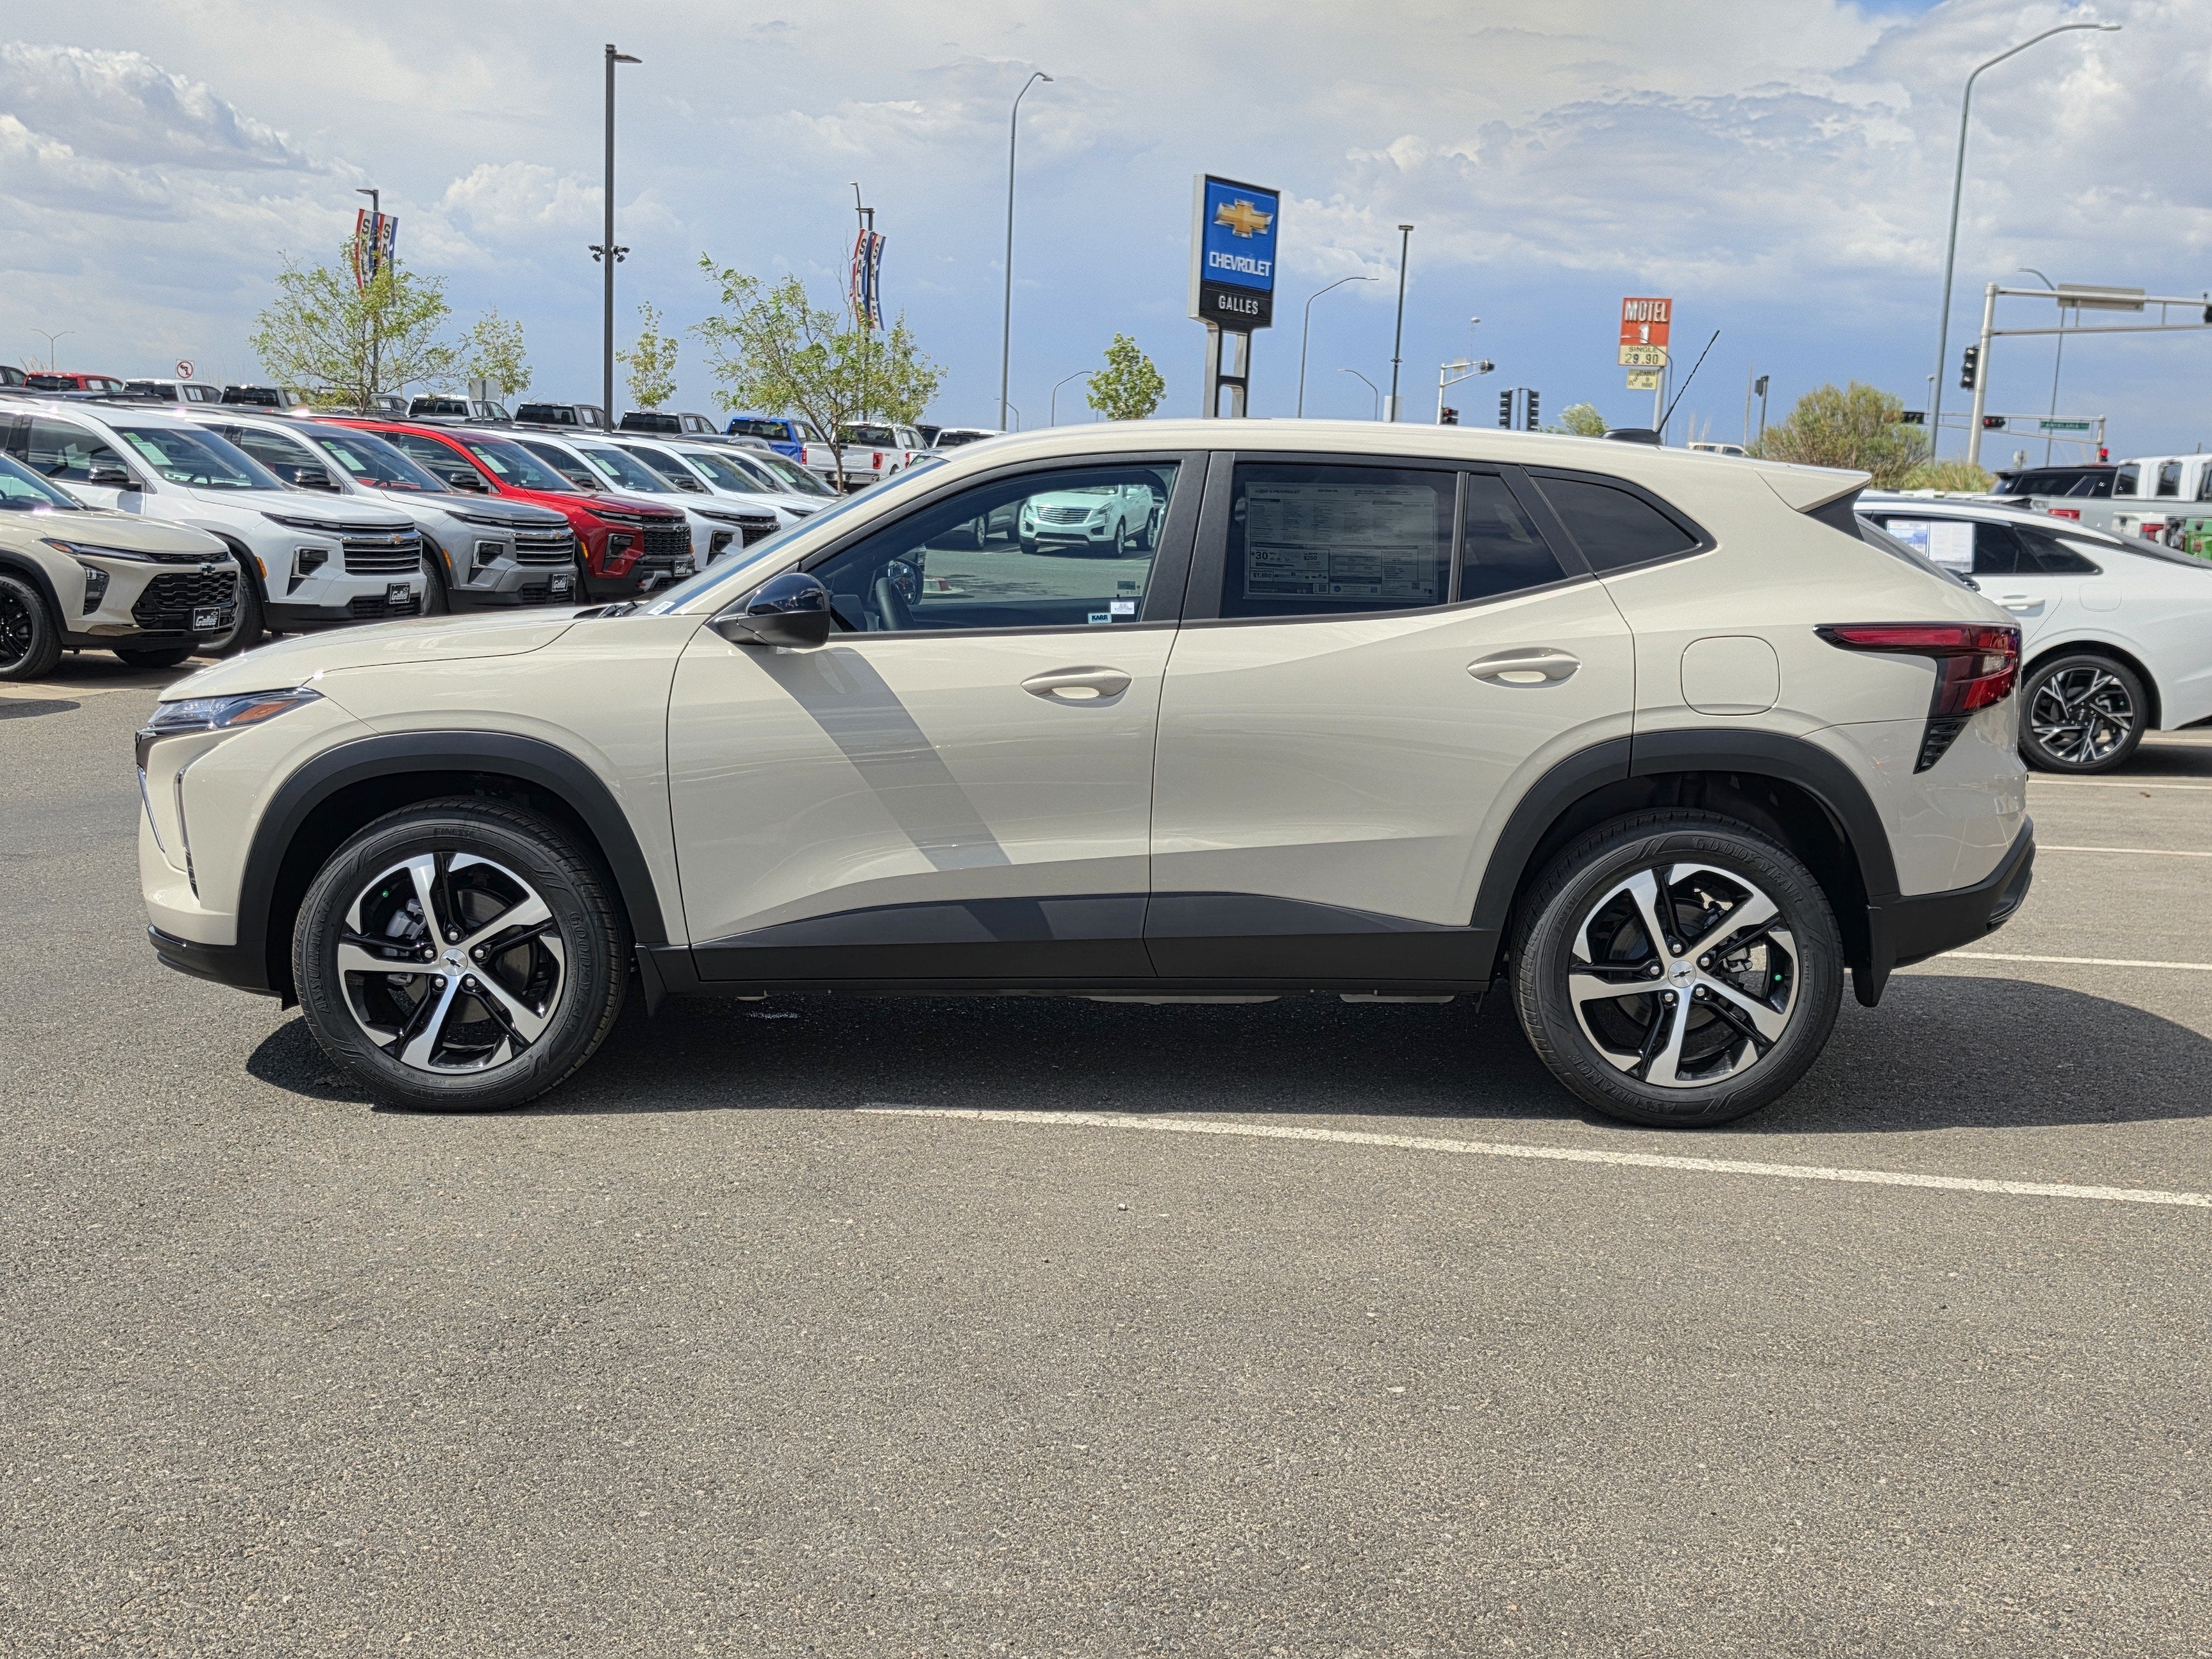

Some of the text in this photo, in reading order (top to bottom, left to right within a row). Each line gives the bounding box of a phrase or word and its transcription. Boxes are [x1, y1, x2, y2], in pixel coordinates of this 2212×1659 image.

[856, 238, 867, 307] SAL
[1209, 251, 1272, 276] CHEVROLET
[870, 242, 879, 322] SALE
[1218, 295, 1259, 315] GALLES
[1624, 300, 1668, 322] MOTEL
[1639, 324, 1650, 344] 1
[1625, 354, 1658, 364] 29.90
[1255, 551, 1268, 560] 30
[1691, 837, 1804, 904] GOODYEAR
[307, 898, 331, 1014] ASSURANCE
[1567, 1052, 1678, 1114] ASSURANCE
